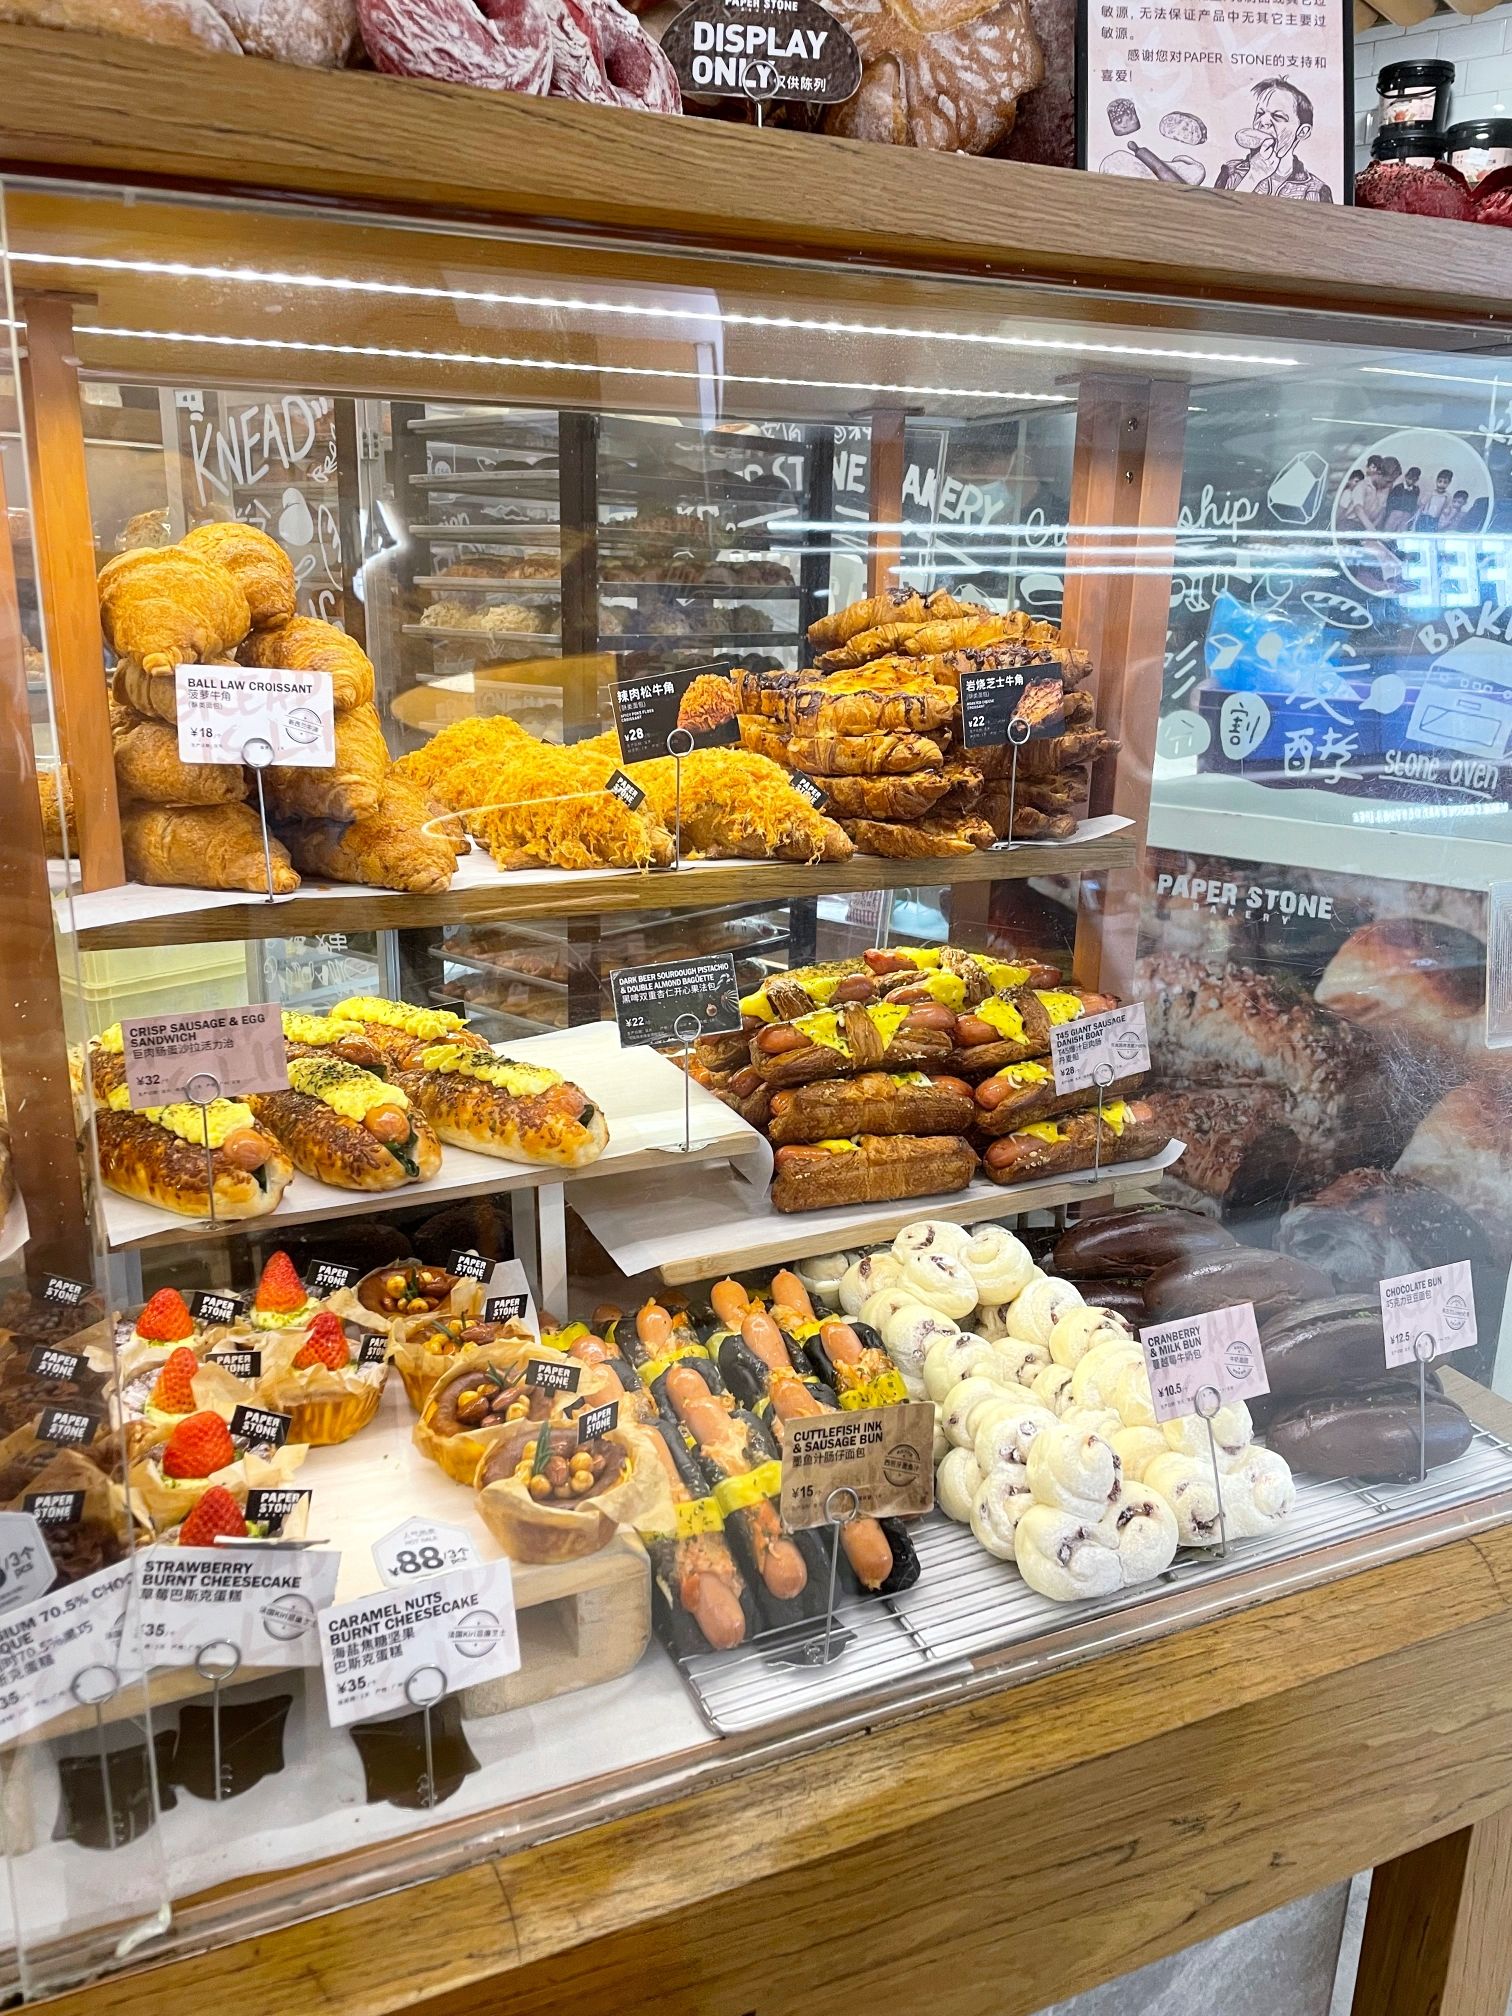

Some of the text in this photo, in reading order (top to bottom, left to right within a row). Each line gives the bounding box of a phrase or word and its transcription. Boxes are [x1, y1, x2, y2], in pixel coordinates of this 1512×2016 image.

[764, 0, 799, 11] STONE
[693, 21, 828, 60] DISPLAY
[692, 55, 775, 89] ONLY
[772, 450, 867, 493] STNE
[188, 678, 313, 694] BALL LAW CROISSANT
[966, 673, 1024, 691] 岩烧芝士牛角
[188, 689, 231, 702] 菠萝牛角
[616, 681, 675, 704] 辣肉松牛角
[968, 715, 985, 728] ¥22
[624, 728, 644, 742] ¥28
[616, 776, 639, 798] PAPER
[799, 778, 822, 799] PAPER
[1157, 873, 1334, 920] PAPER STONE
[619, 962, 729, 986] DARK BEER SOURDOUGH PISTACHIO
[627, 984, 654, 994] DOUBLE
[654, 978, 682, 989] ALMOND
[129, 1013, 266, 1038] CRISP SAUSAGE & EGG
[625, 1016, 645, 1028] ¥22
[1056, 1014, 1126, 1040] T45 GIANT SAUSAGE
[131, 1032, 197, 1048] SANDWICH
[1056, 1029, 1104, 1048] DANISH BOAT
[133, 1038, 235, 1060] 巨肉肠蛋沙拉活力治
[455, 1263, 485, 1277] STONE
[458, 1255, 487, 1269] PAPER
[316, 1273, 347, 1286] STONE
[318, 1265, 349, 1278] PAPER
[49, 1279, 82, 1294] PAPER
[1385, 1276, 1443, 1298] CHOCOLATE BUN
[46, 1287, 79, 1303] STONE
[494, 1297, 520, 1309] PAPER
[200, 1304, 233, 1319] STONE
[202, 1296, 235, 1311] PAPER
[493, 1305, 519, 1317] STONE
[1148, 1326, 1201, 1348] CRANBERRY
[1390, 1331, 1410, 1345] ¥12.5
[1150, 1337, 1202, 1358] & MILK BUN
[42, 1351, 78, 1367] PAPER
[216, 1354, 251, 1365] PAPER
[39, 1361, 75, 1377] STONE
[222, 1363, 251, 1373] TONE
[537, 1364, 571, 1378] PAPER
[536, 1373, 570, 1386] STONE
[1158, 1383, 1182, 1398] ¥10.5
[53, 1412, 90, 1427] PAPER
[244, 1411, 280, 1427] PAPER
[586, 1407, 612, 1425] PAPER
[49, 1423, 87, 1438] STONE
[242, 1421, 278, 1437] STONE
[586, 1416, 611, 1435] STONE
[793, 1420, 883, 1442] CUTTLEFISH INK
[792, 1432, 883, 1454] & SAUSAGE BUN
[792, 1447, 866, 1468] 墨鱼汁肠仔面包
[34, 1494, 75, 1509] PAPER
[261, 1492, 300, 1504] PAPER
[32, 1505, 72, 1519] STONE
[258, 1502, 294, 1514] STON
[144, 1561, 254, 1574] STRAWBERRY
[387, 1546, 444, 1577] ¥88
[142, 1574, 302, 1589] BURNT CHEESECAKE
[140, 1588, 243, 1603] 草莓巴斯克蛋糕
[39, 1592, 89, 1623] 70.5%
[328, 1591, 443, 1633] CARAMEL NUTS
[329, 1594, 479, 1646] BURNT CHEESECAKE
[331, 1627, 416, 1661] 海盐焦糖坚果
[333, 1643, 404, 1675] 巴斯克蛋糕
[336, 1676, 367, 1695] ¥35
